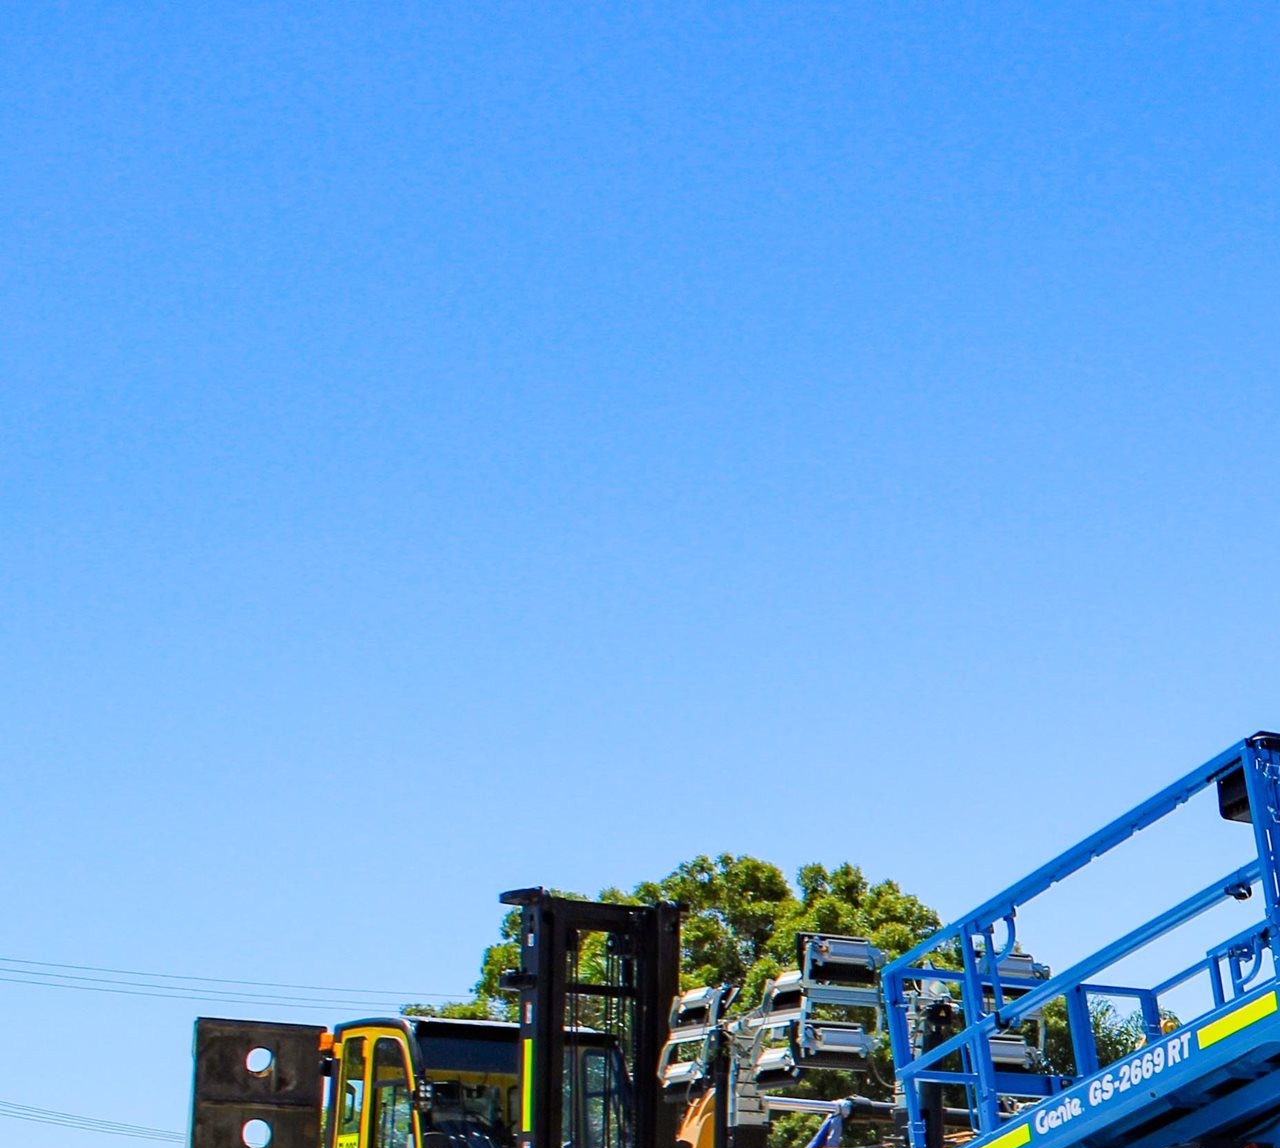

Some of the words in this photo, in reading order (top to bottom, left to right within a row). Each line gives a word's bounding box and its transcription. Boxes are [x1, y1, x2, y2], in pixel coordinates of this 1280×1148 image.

[1035, 1097, 1081, 1135] Genie
[1088, 1046, 1165, 1107] GS-2669
[1168, 1032, 1193, 1068] RT
